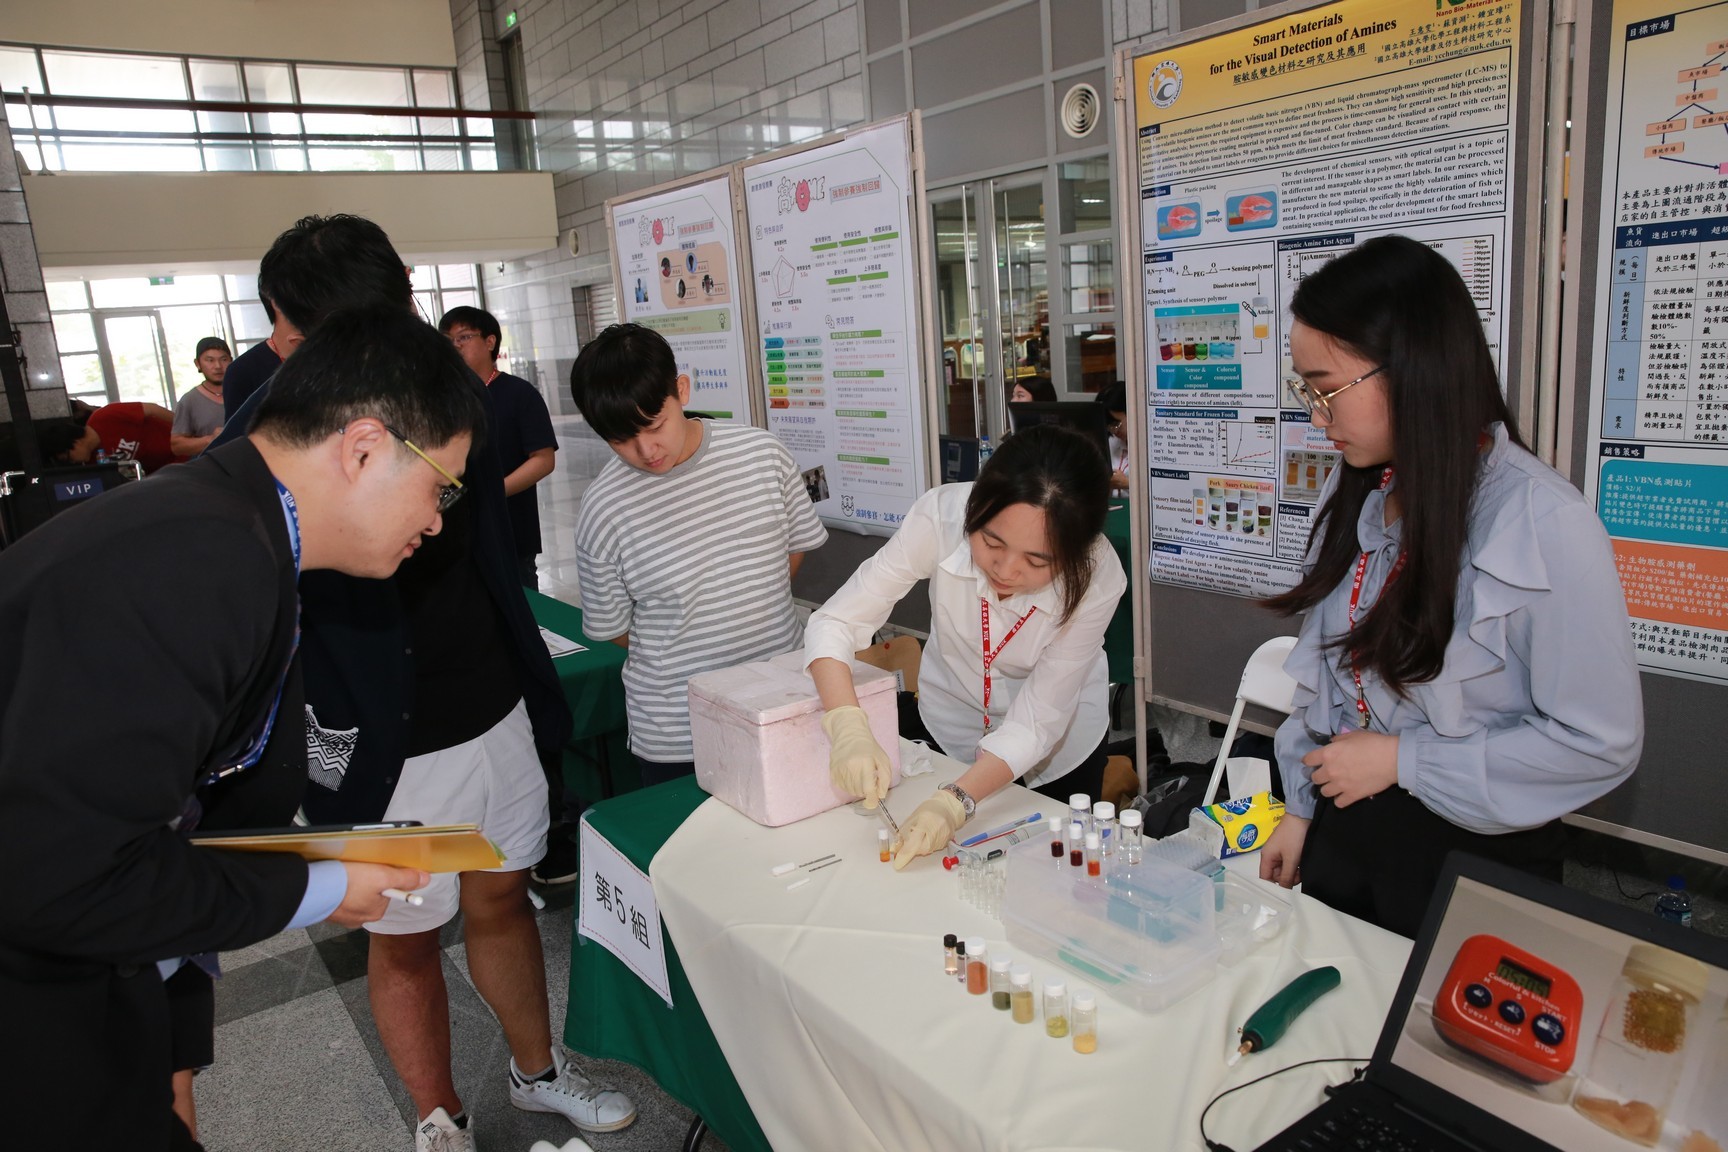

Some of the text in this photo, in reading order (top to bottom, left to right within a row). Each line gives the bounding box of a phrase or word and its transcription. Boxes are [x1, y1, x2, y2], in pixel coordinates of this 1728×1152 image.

[1436, 9, 1452, 17] Nano
[1253, 13, 1343, 46] Smart Materials
[1630, 20, 1671, 37] 目標市場
[1210, 63, 1224, 75] for
[1227, 57, 1242, 70] the
[1244, 48, 1277, 66] Visual
[1280, 36, 1333, 57] Detection
[1336, 29, 1349, 43] of
[1350, 19, 1397, 40] Amines
[1409, 38, 1511, 66] E-mail: ycchung@nuk.edu.tw
[1422, 72, 1462, 85] spectrometer
[1464, 64, 1496, 76] (LC-MS)
[1350, 135, 1390, 145] miscellaneous
[1391, 129, 1417, 138] detection
[1419, 124, 1449, 132] situations.
[1294, 166, 1329, 175] development
[1340, 159, 1366, 168] chemical
[1410, 148, 1431, 158] optical
[1434, 144, 1455, 153] output
[1475, 138, 1492, 147] topic
[1376, 164, 1402, 173] polymer,
[1415, 156, 1442, 166] material
[1468, 147, 1504, 159] processed
[1334, 216, 1358, 224] material
[1451, 202, 1466, 210] food
[1468, 199, 1504, 208] freshness.
[1652, 228, 1698, 240] 進出口市場
[1626, 239, 1642, 247] 流向
[1656, 253, 1696, 262] 進出口總量
[1654, 287, 1694, 295] 依法規檢驗
[1604, 446, 1640, 456] 銷售策略
[66, 484, 90, 495] VIP
[1634, 476, 1692, 488] VBN感測貼片
[595, 871, 650, 949] 第5組
[1488, 972, 1521, 992] Colorful
[1531, 994, 1560, 1011] kitchen
[1542, 1006, 1567, 1022] START
[1535, 1041, 1556, 1054] STOP
